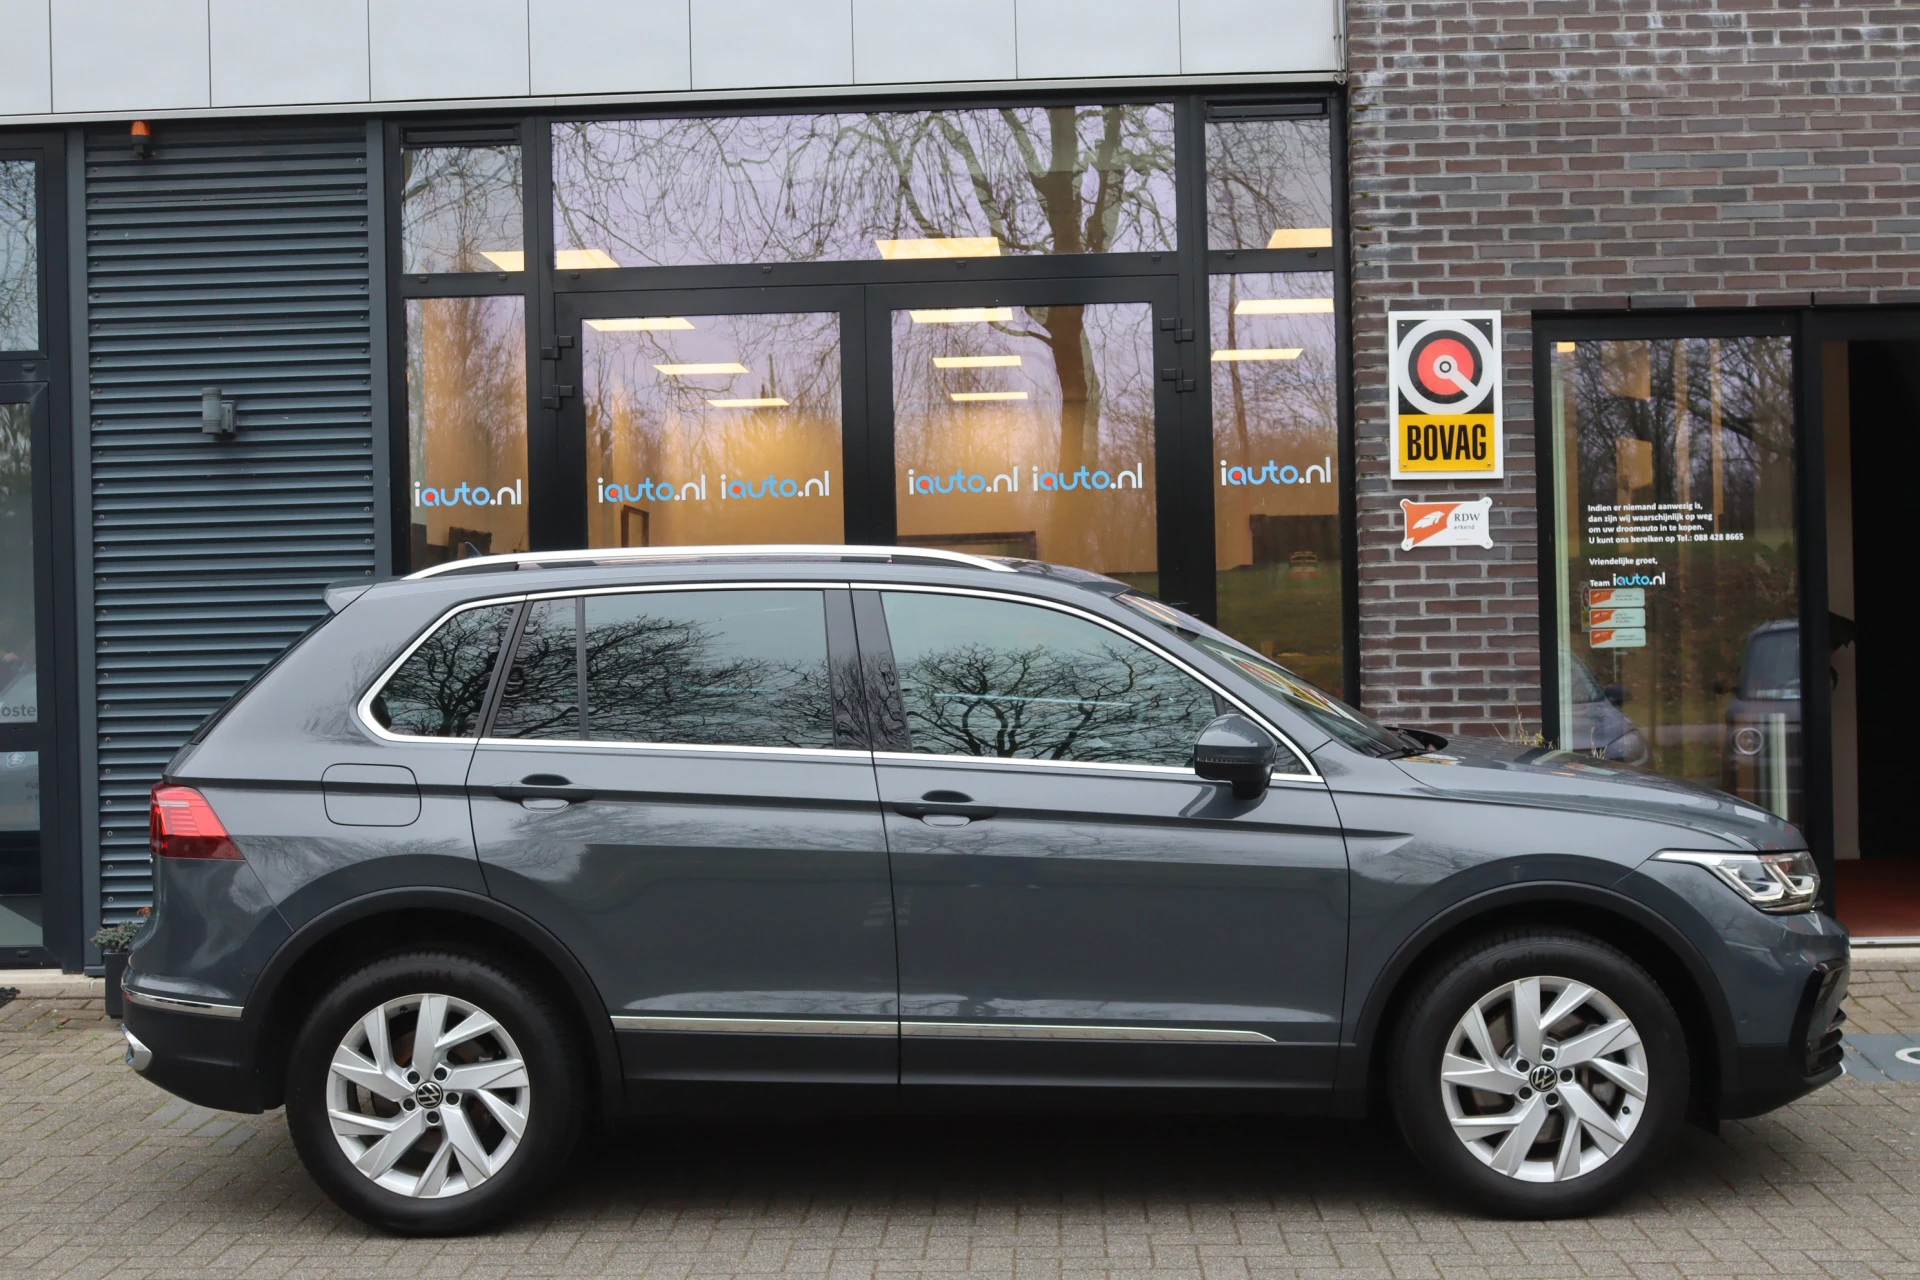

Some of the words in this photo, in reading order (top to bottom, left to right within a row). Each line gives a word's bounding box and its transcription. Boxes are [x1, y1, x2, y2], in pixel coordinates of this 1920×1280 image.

[1407, 424, 1487, 461] BOVAG
[1219, 456, 1331, 486] iauto.nl
[908, 465, 1019, 495] iauto.nl
[1032, 462, 1143, 492] iauto.nl
[414, 478, 522, 507] iauto.nl
[597, 474, 706, 504] iauto.nl
[720, 470, 830, 499] iauto.nl
[1588, 504, 1612, 512] Indien
[1623, 502, 1656, 511] niemand
[1658, 502, 1693, 511] aanwezig
[1694, 502, 1703, 510] is,
[1454, 513, 1481, 522] RDW
[1604, 514, 1617, 523] zijn
[1619, 514, 1631, 523] wij
[1632, 513, 1683, 522] waarschijnlijk
[1685, 514, 1695, 522] op
[1696, 514, 1712, 522] weg
[1588, 526, 1601, 534] om
[1616, 525, 1658, 533] droomauto
[1660, 524, 1667, 532] in
[1678, 523, 1704, 532] kopen.
[1596, 536, 1614, 544] kunt
[1630, 535, 1664, 543] bereiken
[1676, 534, 1692, 542] Tel.:
[1694, 534, 1708, 542] 088
[1709, 533, 1723, 541] 428
[1725, 533, 1744, 541] 8665
[1589, 557, 1634, 566] Vriendelijke
[1635, 558, 1658, 566] groet,
[1589, 579, 1610, 587] Team
[1612, 572, 1666, 586] iauto.nl
